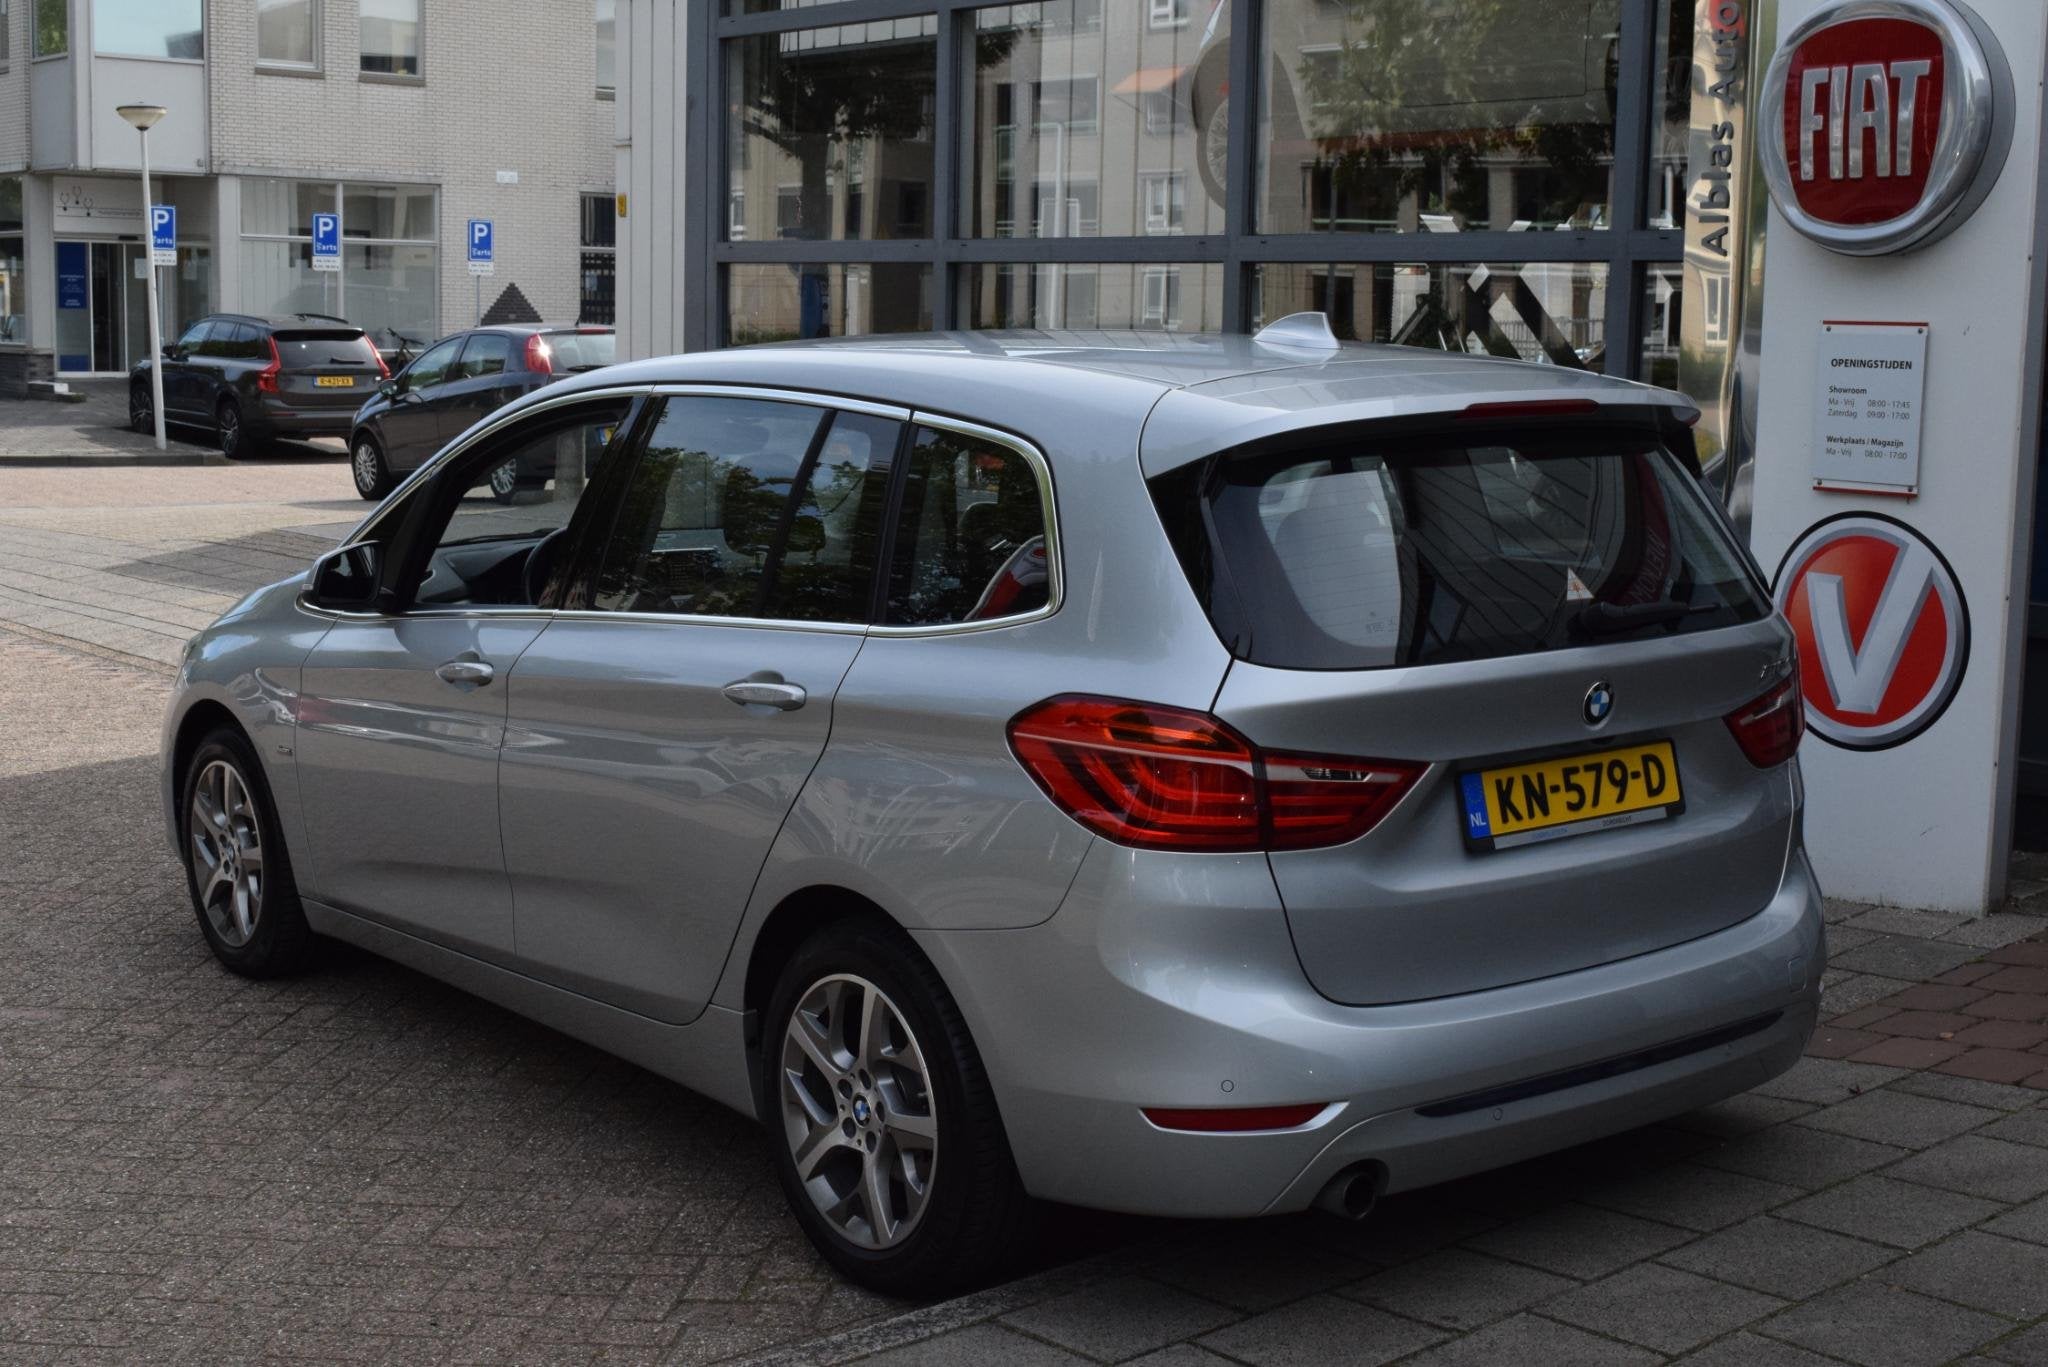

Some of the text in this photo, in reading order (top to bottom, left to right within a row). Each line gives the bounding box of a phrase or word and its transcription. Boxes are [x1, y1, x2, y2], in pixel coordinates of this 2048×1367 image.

[1800, 59, 1931, 182] FIAT
[1698, 120, 1735, 258] Alblas
[153, 209, 170, 232] P
[318, 217, 334, 238] P
[474, 223, 488, 244] P
[1831, 358, 1913, 370] OPENINGSTIJDEN
[1828, 385, 1868, 395] Showroom
[1828, 397, 1837, 406] Ma
[1843, 398, 1855, 407] Vrij
[1867, 399, 1886, 408] 08:00
[1892, 400, 1911, 409] 17:45
[1827, 409, 1858, 419] Zaterdag
[1867, 410, 1885, 419] 09:00
[1891, 411, 1910, 420] 17:00
[1826, 435, 1866, 446] Werkplaats
[1870, 438, 1904, 449] Magazijn
[1826, 447, 1835, 455] Ma
[1841, 448, 1852, 457] Vrij
[1864, 449, 1883, 458] 08:00
[1889, 451, 1908, 460] 17:00
[1495, 753, 1666, 824] KN-579-D
[1469, 811, 1487, 828] NL
